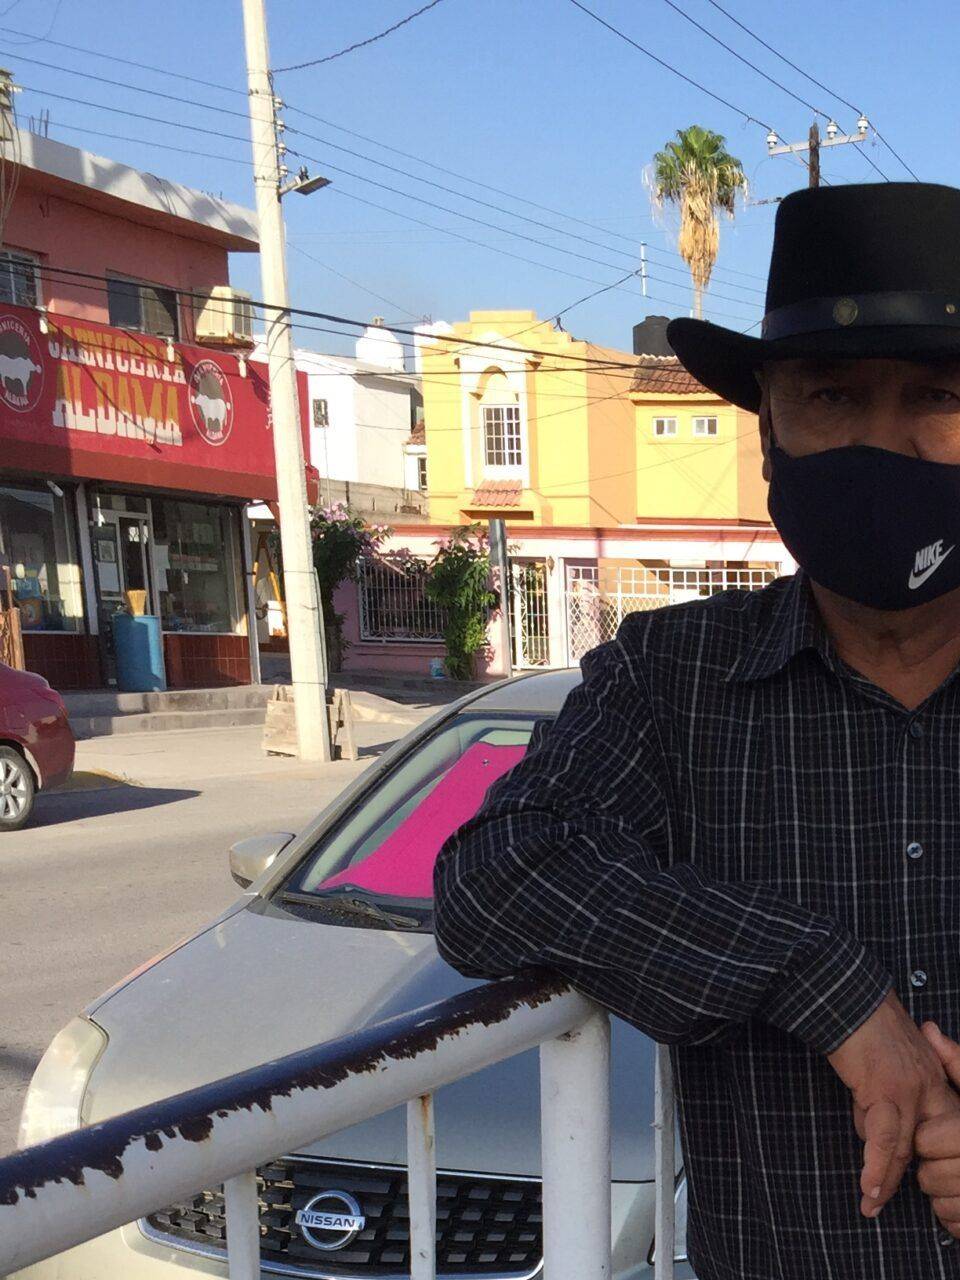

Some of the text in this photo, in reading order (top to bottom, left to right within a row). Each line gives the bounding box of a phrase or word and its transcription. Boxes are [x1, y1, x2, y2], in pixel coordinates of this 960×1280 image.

[0, 320, 31, 346] NICERIA
[47, 320, 187, 384] CARNICERIA
[52, 363, 183, 446] ALDAMA
[914, 539, 944, 573] NIKE
[301, 1213, 356, 1228] NISSAN
